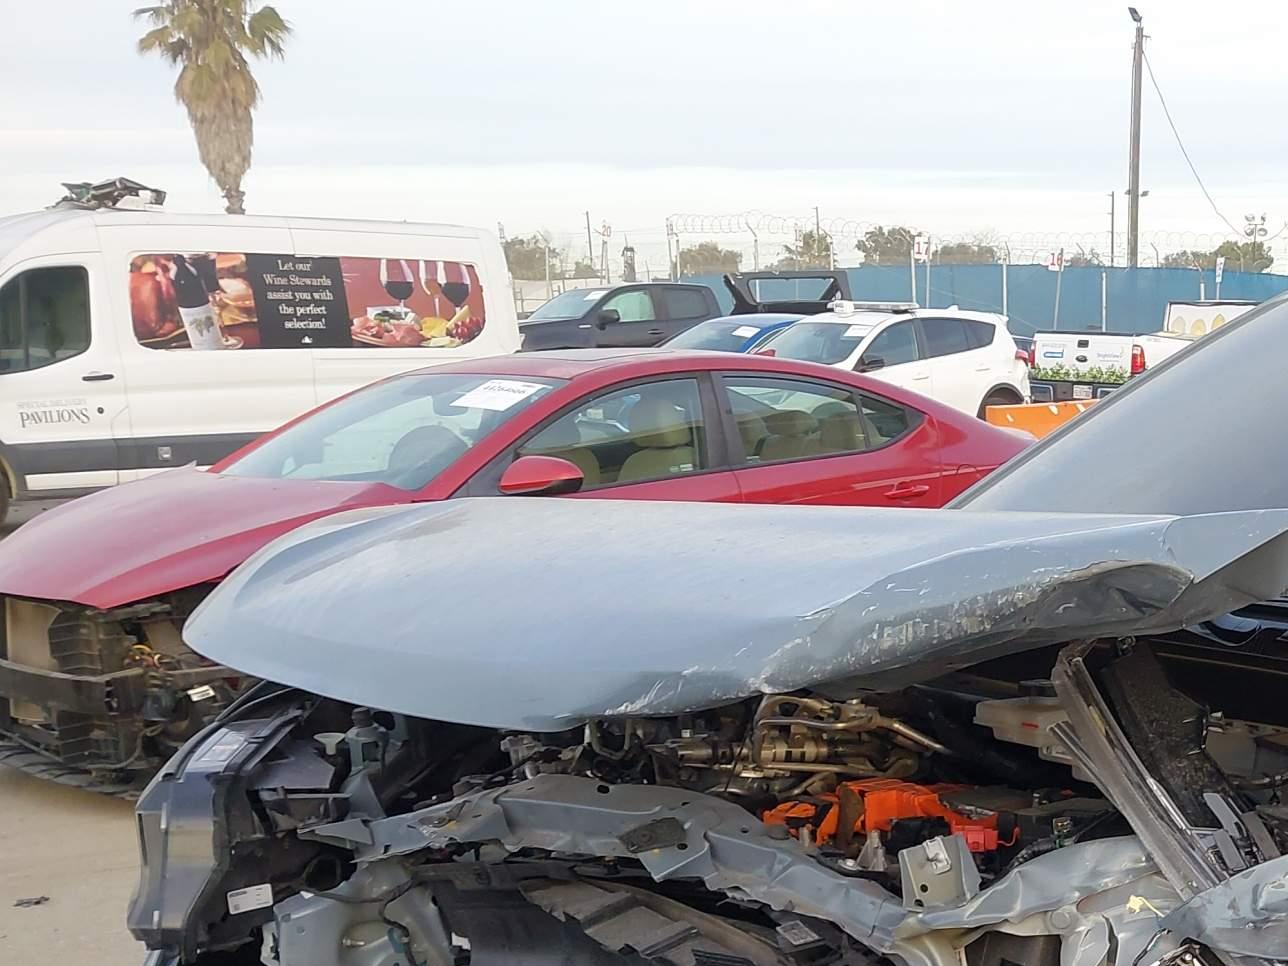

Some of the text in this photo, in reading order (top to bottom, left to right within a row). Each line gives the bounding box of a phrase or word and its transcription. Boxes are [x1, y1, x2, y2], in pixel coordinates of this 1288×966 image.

[915, 242, 930, 255] 17
[277, 260, 312, 271] Let our
[263, 274, 332, 286] Wine Stewards
[267, 289, 334, 302] assist you with
[279, 303, 327, 316] the perfect
[284, 318, 326, 329] selection!
[19, 408, 91, 428] PAVILIONS
